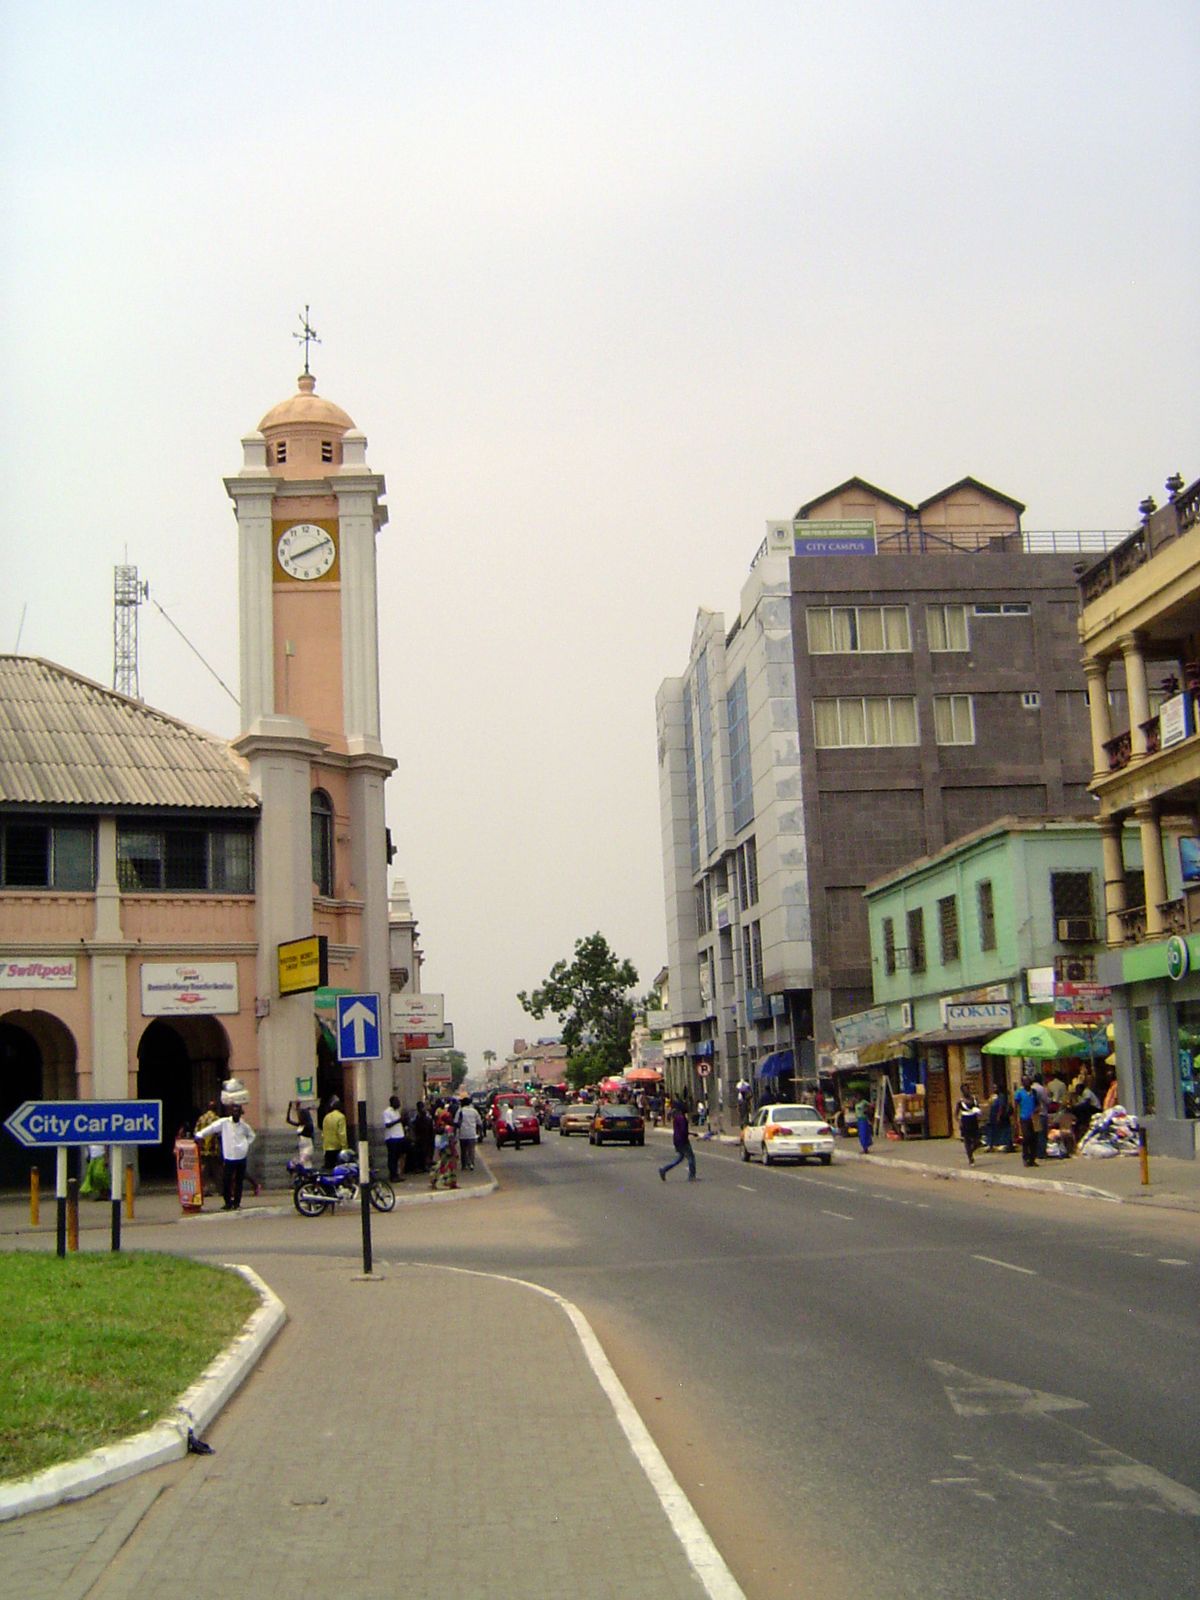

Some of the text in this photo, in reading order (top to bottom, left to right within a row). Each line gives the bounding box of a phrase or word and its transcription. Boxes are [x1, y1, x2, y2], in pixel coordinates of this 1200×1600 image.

[806, 543, 865, 551] CITY CAMPUS
[7, 963, 73, 979] Swiftpost
[949, 1006, 1009, 1018] GOKALS
[29, 1113, 156, 1136] City Car Park
